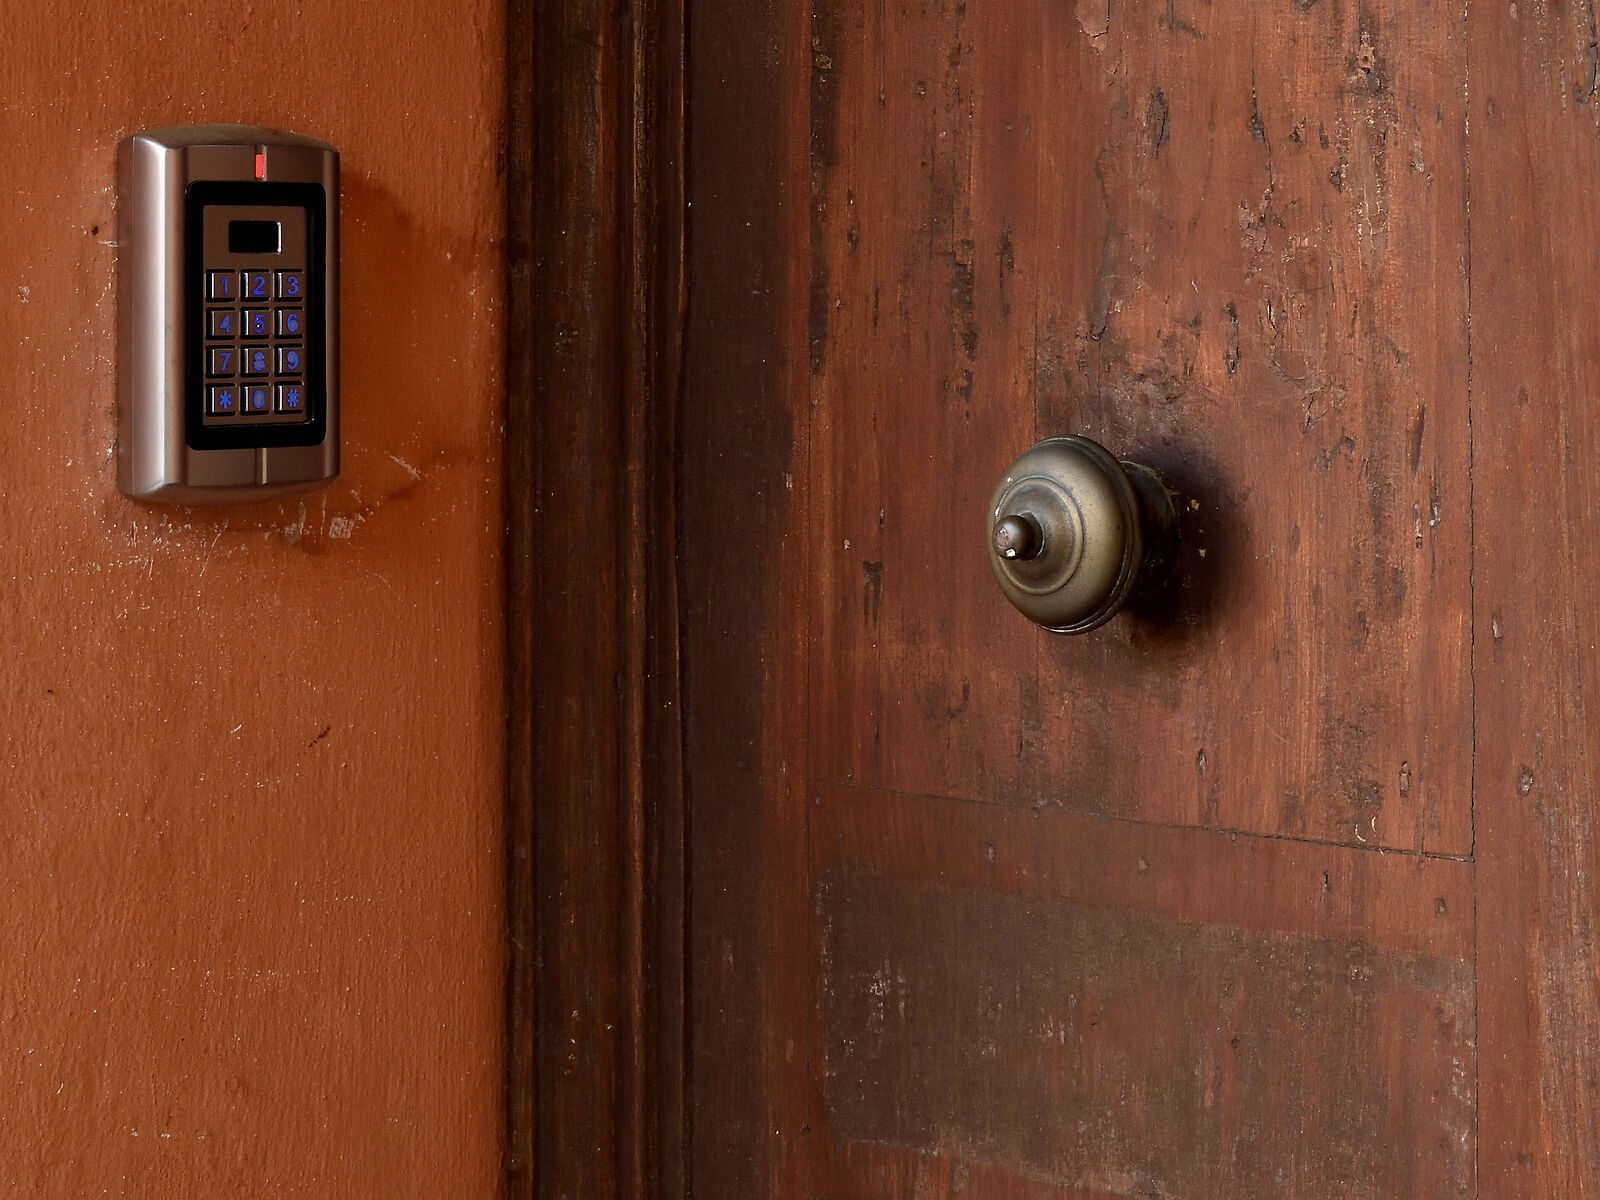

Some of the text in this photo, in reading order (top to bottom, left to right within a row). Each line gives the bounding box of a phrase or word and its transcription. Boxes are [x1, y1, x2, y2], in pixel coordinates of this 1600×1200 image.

[221, 276, 298, 295] 1 2 3
[219, 313, 298, 333] 4 5 6
[219, 351, 298, 371] 7 8 9
[253, 390, 265, 409] 0
